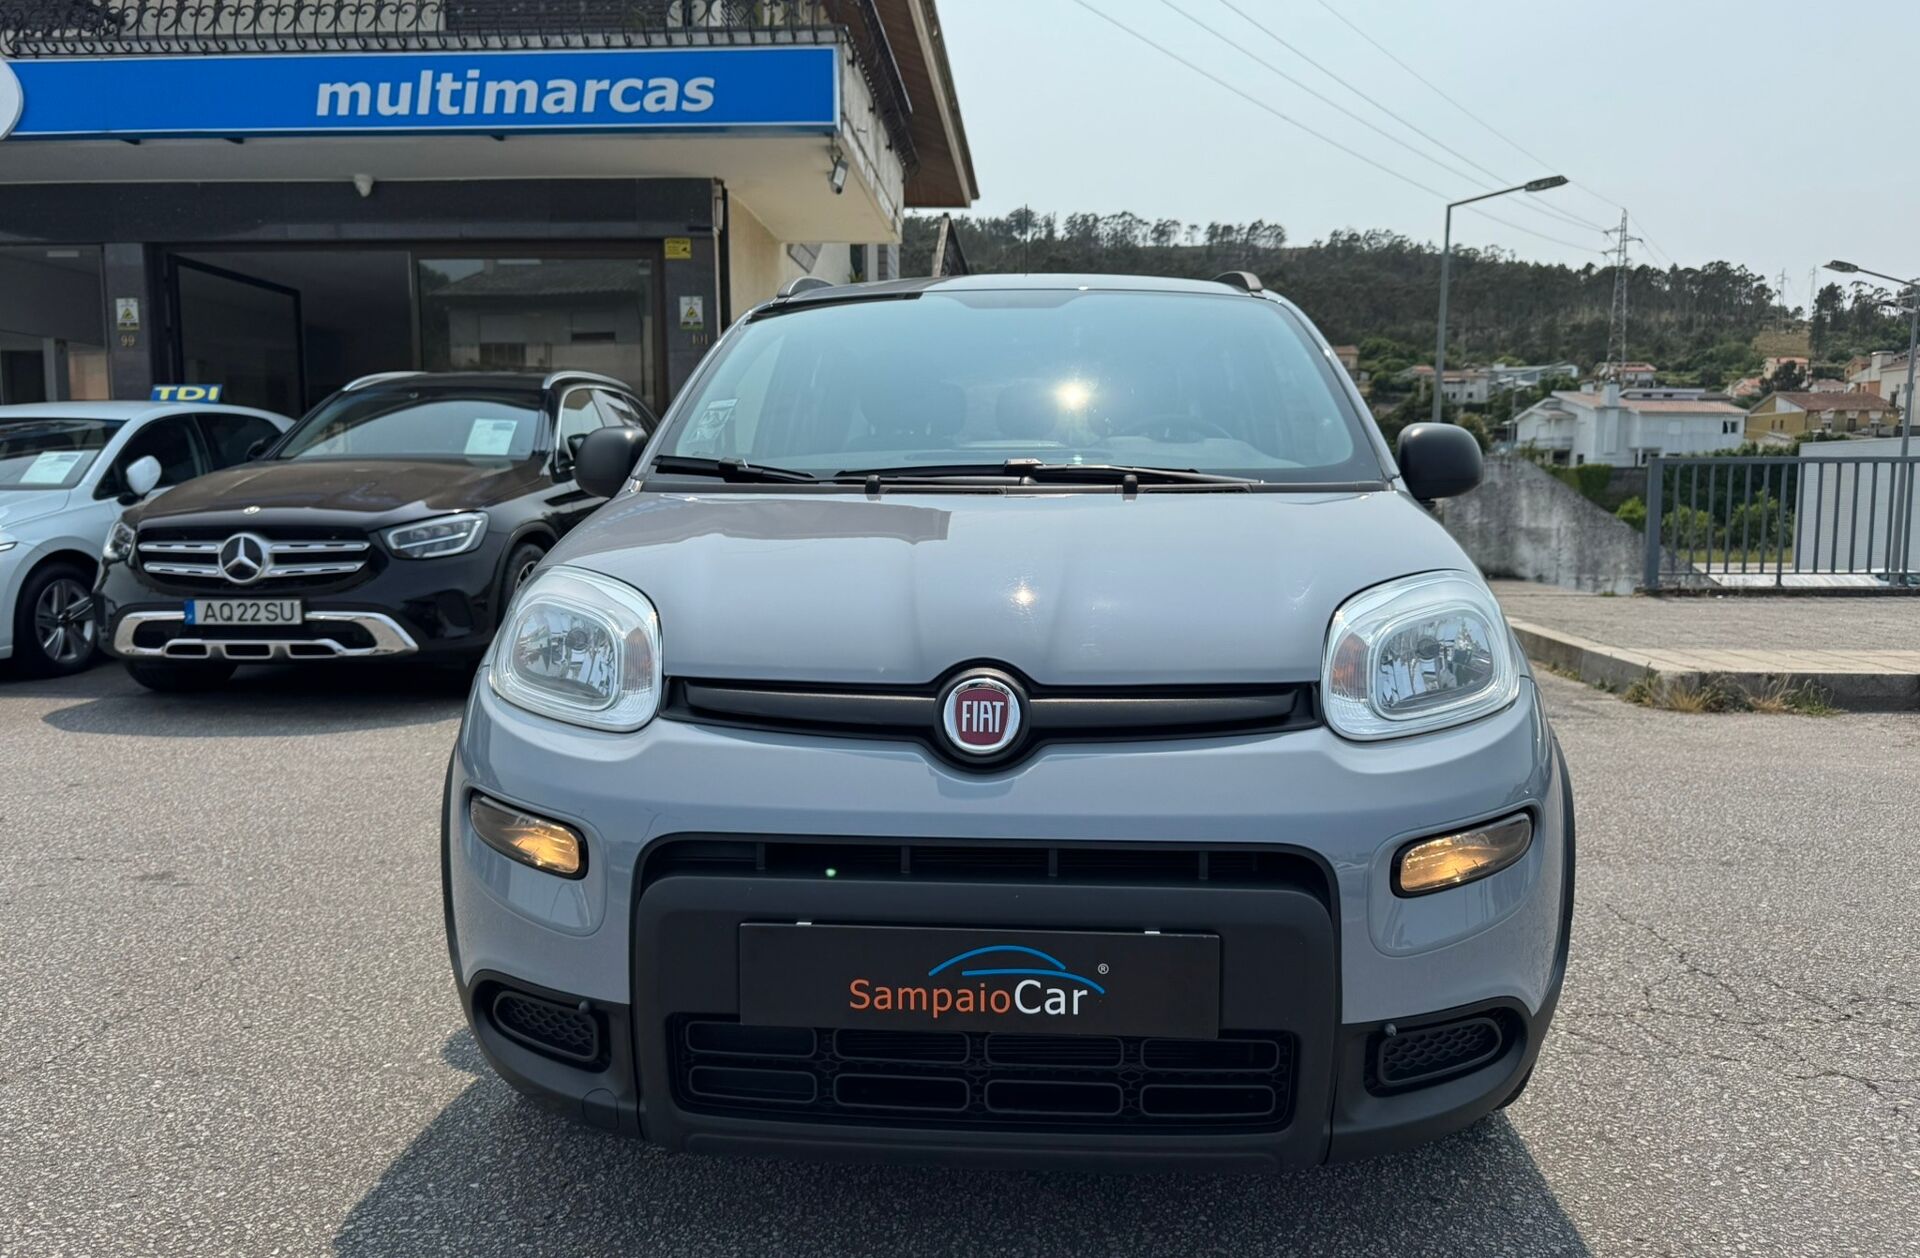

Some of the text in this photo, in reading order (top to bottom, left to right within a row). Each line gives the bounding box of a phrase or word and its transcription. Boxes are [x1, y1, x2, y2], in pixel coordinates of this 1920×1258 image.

[316, 69, 715, 116] multimarcas
[120, 335, 135, 346] 99
[154, 386, 219, 401] TDI
[961, 700, 1005, 733] FIAT
[849, 978, 1088, 1019] SampaioCar
